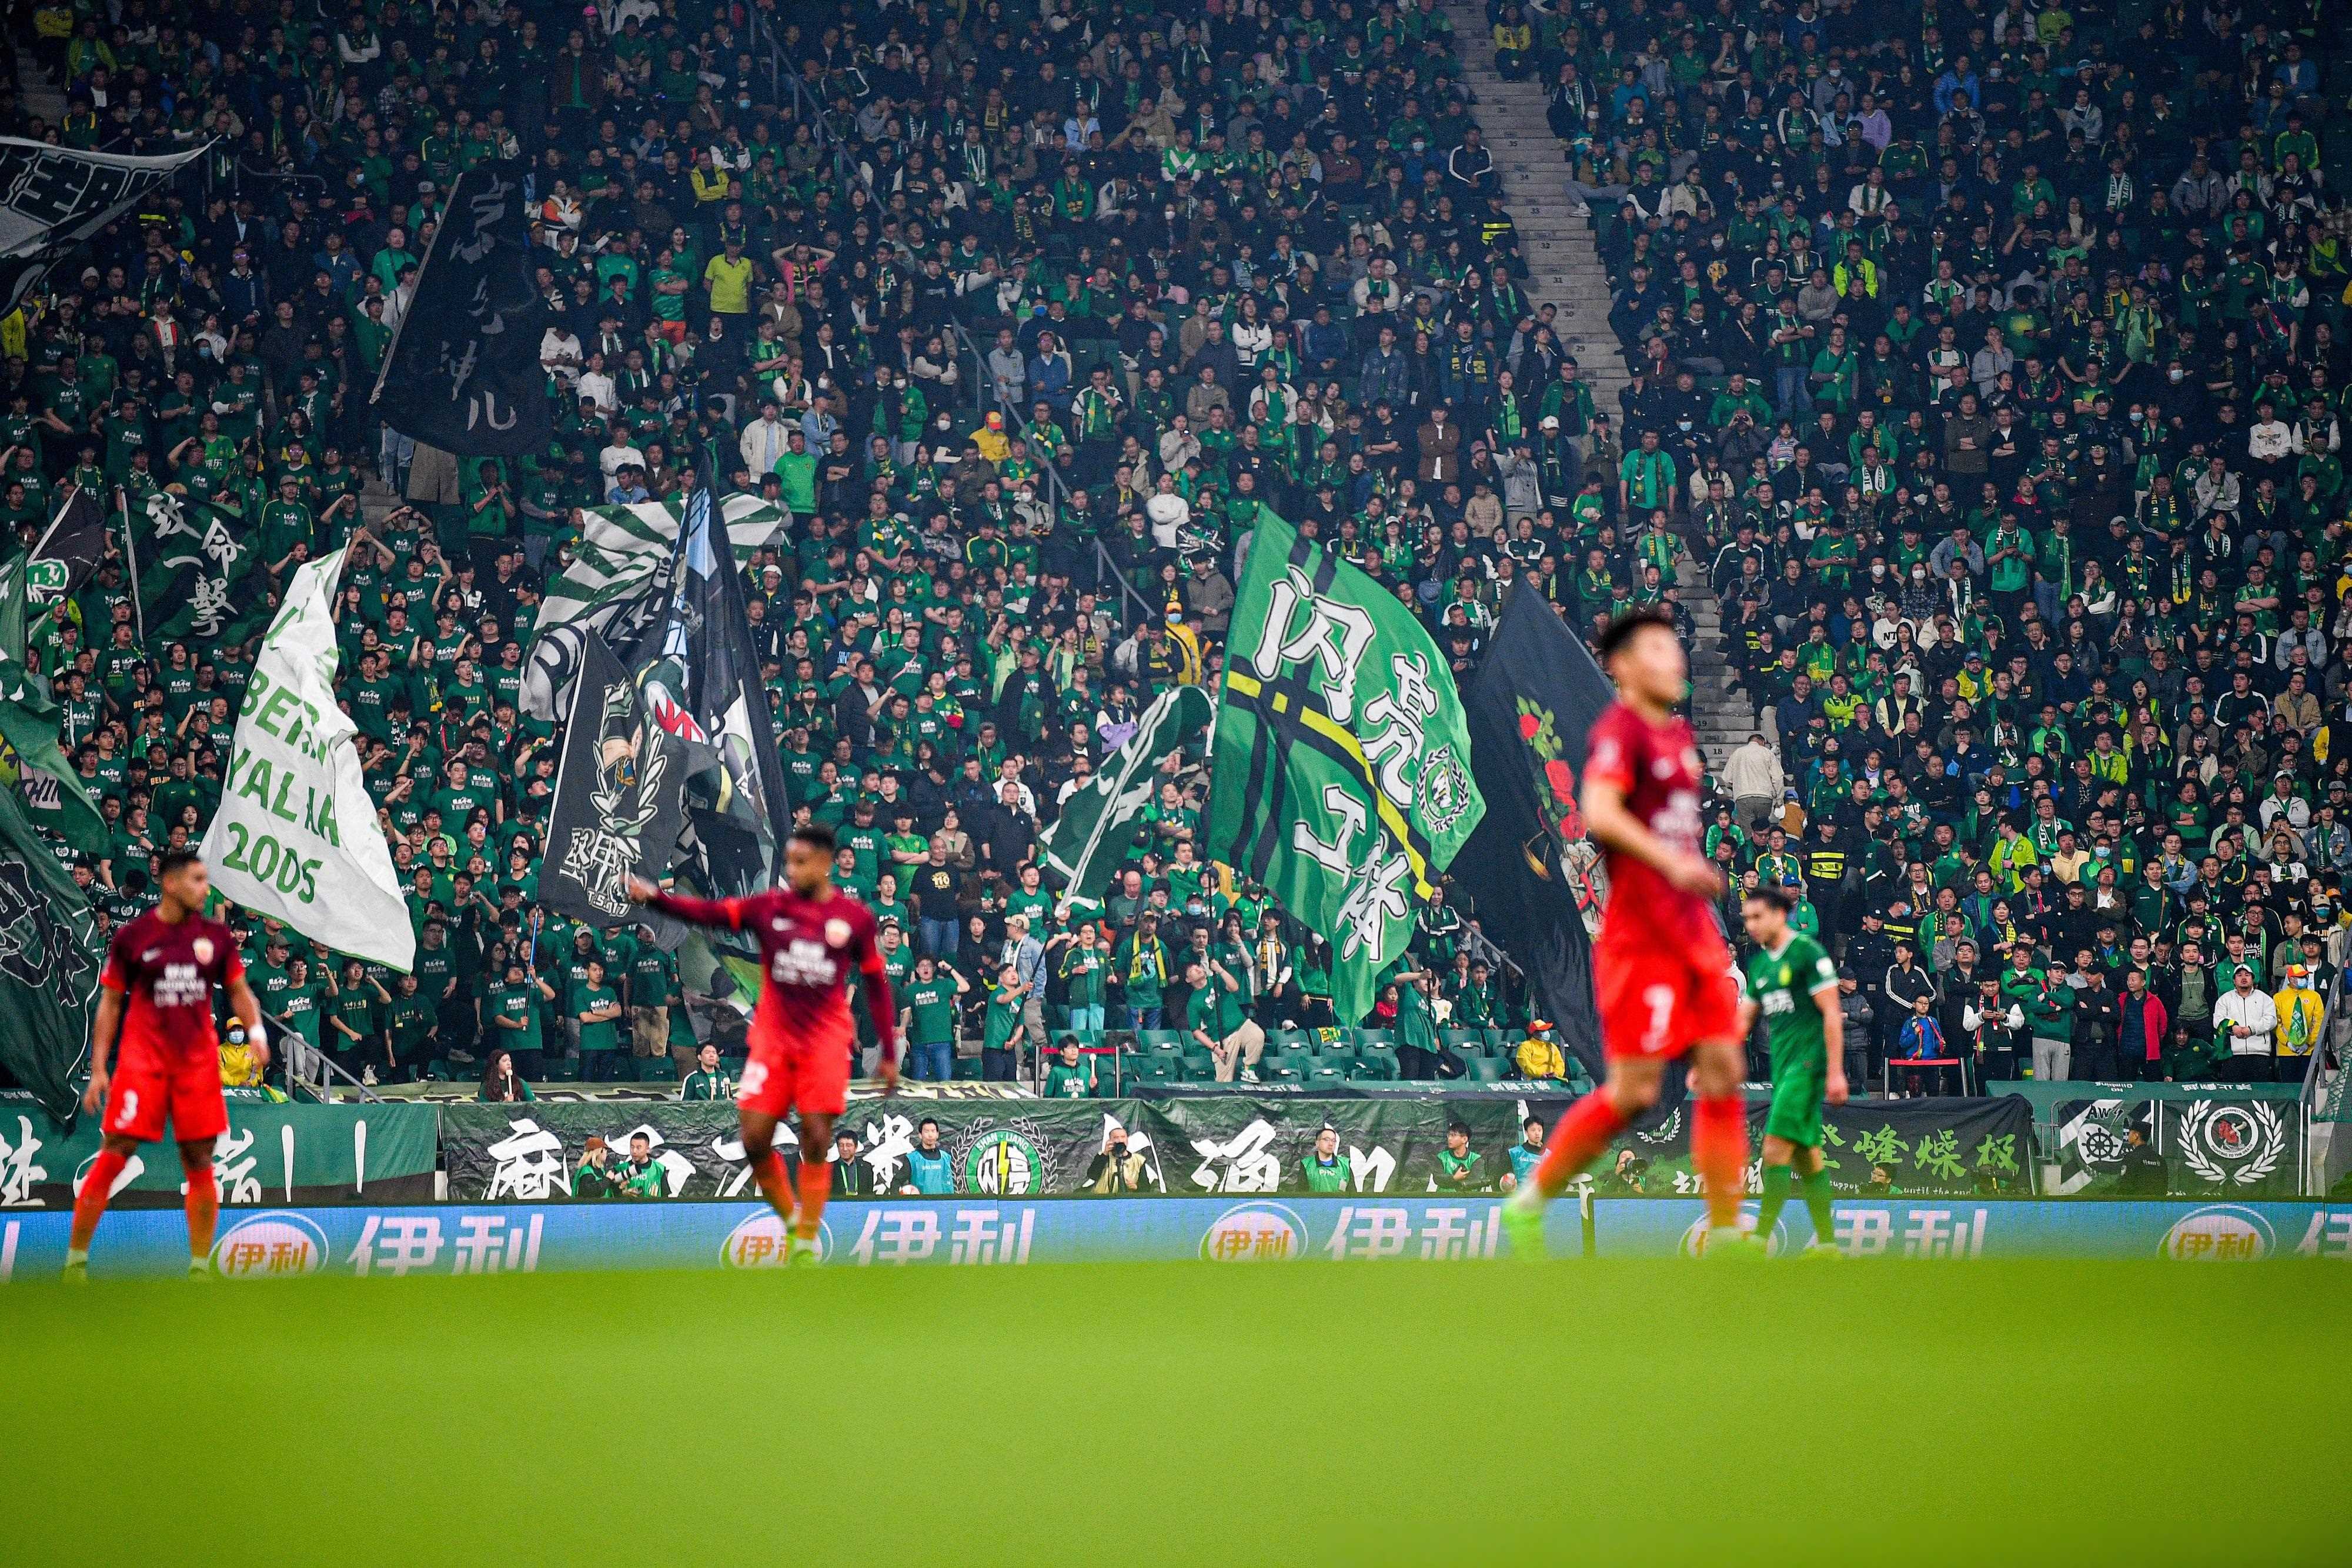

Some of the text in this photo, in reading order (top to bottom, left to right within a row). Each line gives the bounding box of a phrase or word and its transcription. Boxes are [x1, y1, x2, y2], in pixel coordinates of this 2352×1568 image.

[222, 821, 323, 904] 2005
[226, 1242, 308, 1273] 伊利
[346, 1213, 544, 1276] 伊利
[851, 1208, 1035, 1266] 伊利
[1214, 1229, 1290, 1261] 伊利
[1324, 1205, 1501, 1261] 伊利
[2175, 1232, 2257, 1259] 伊利
